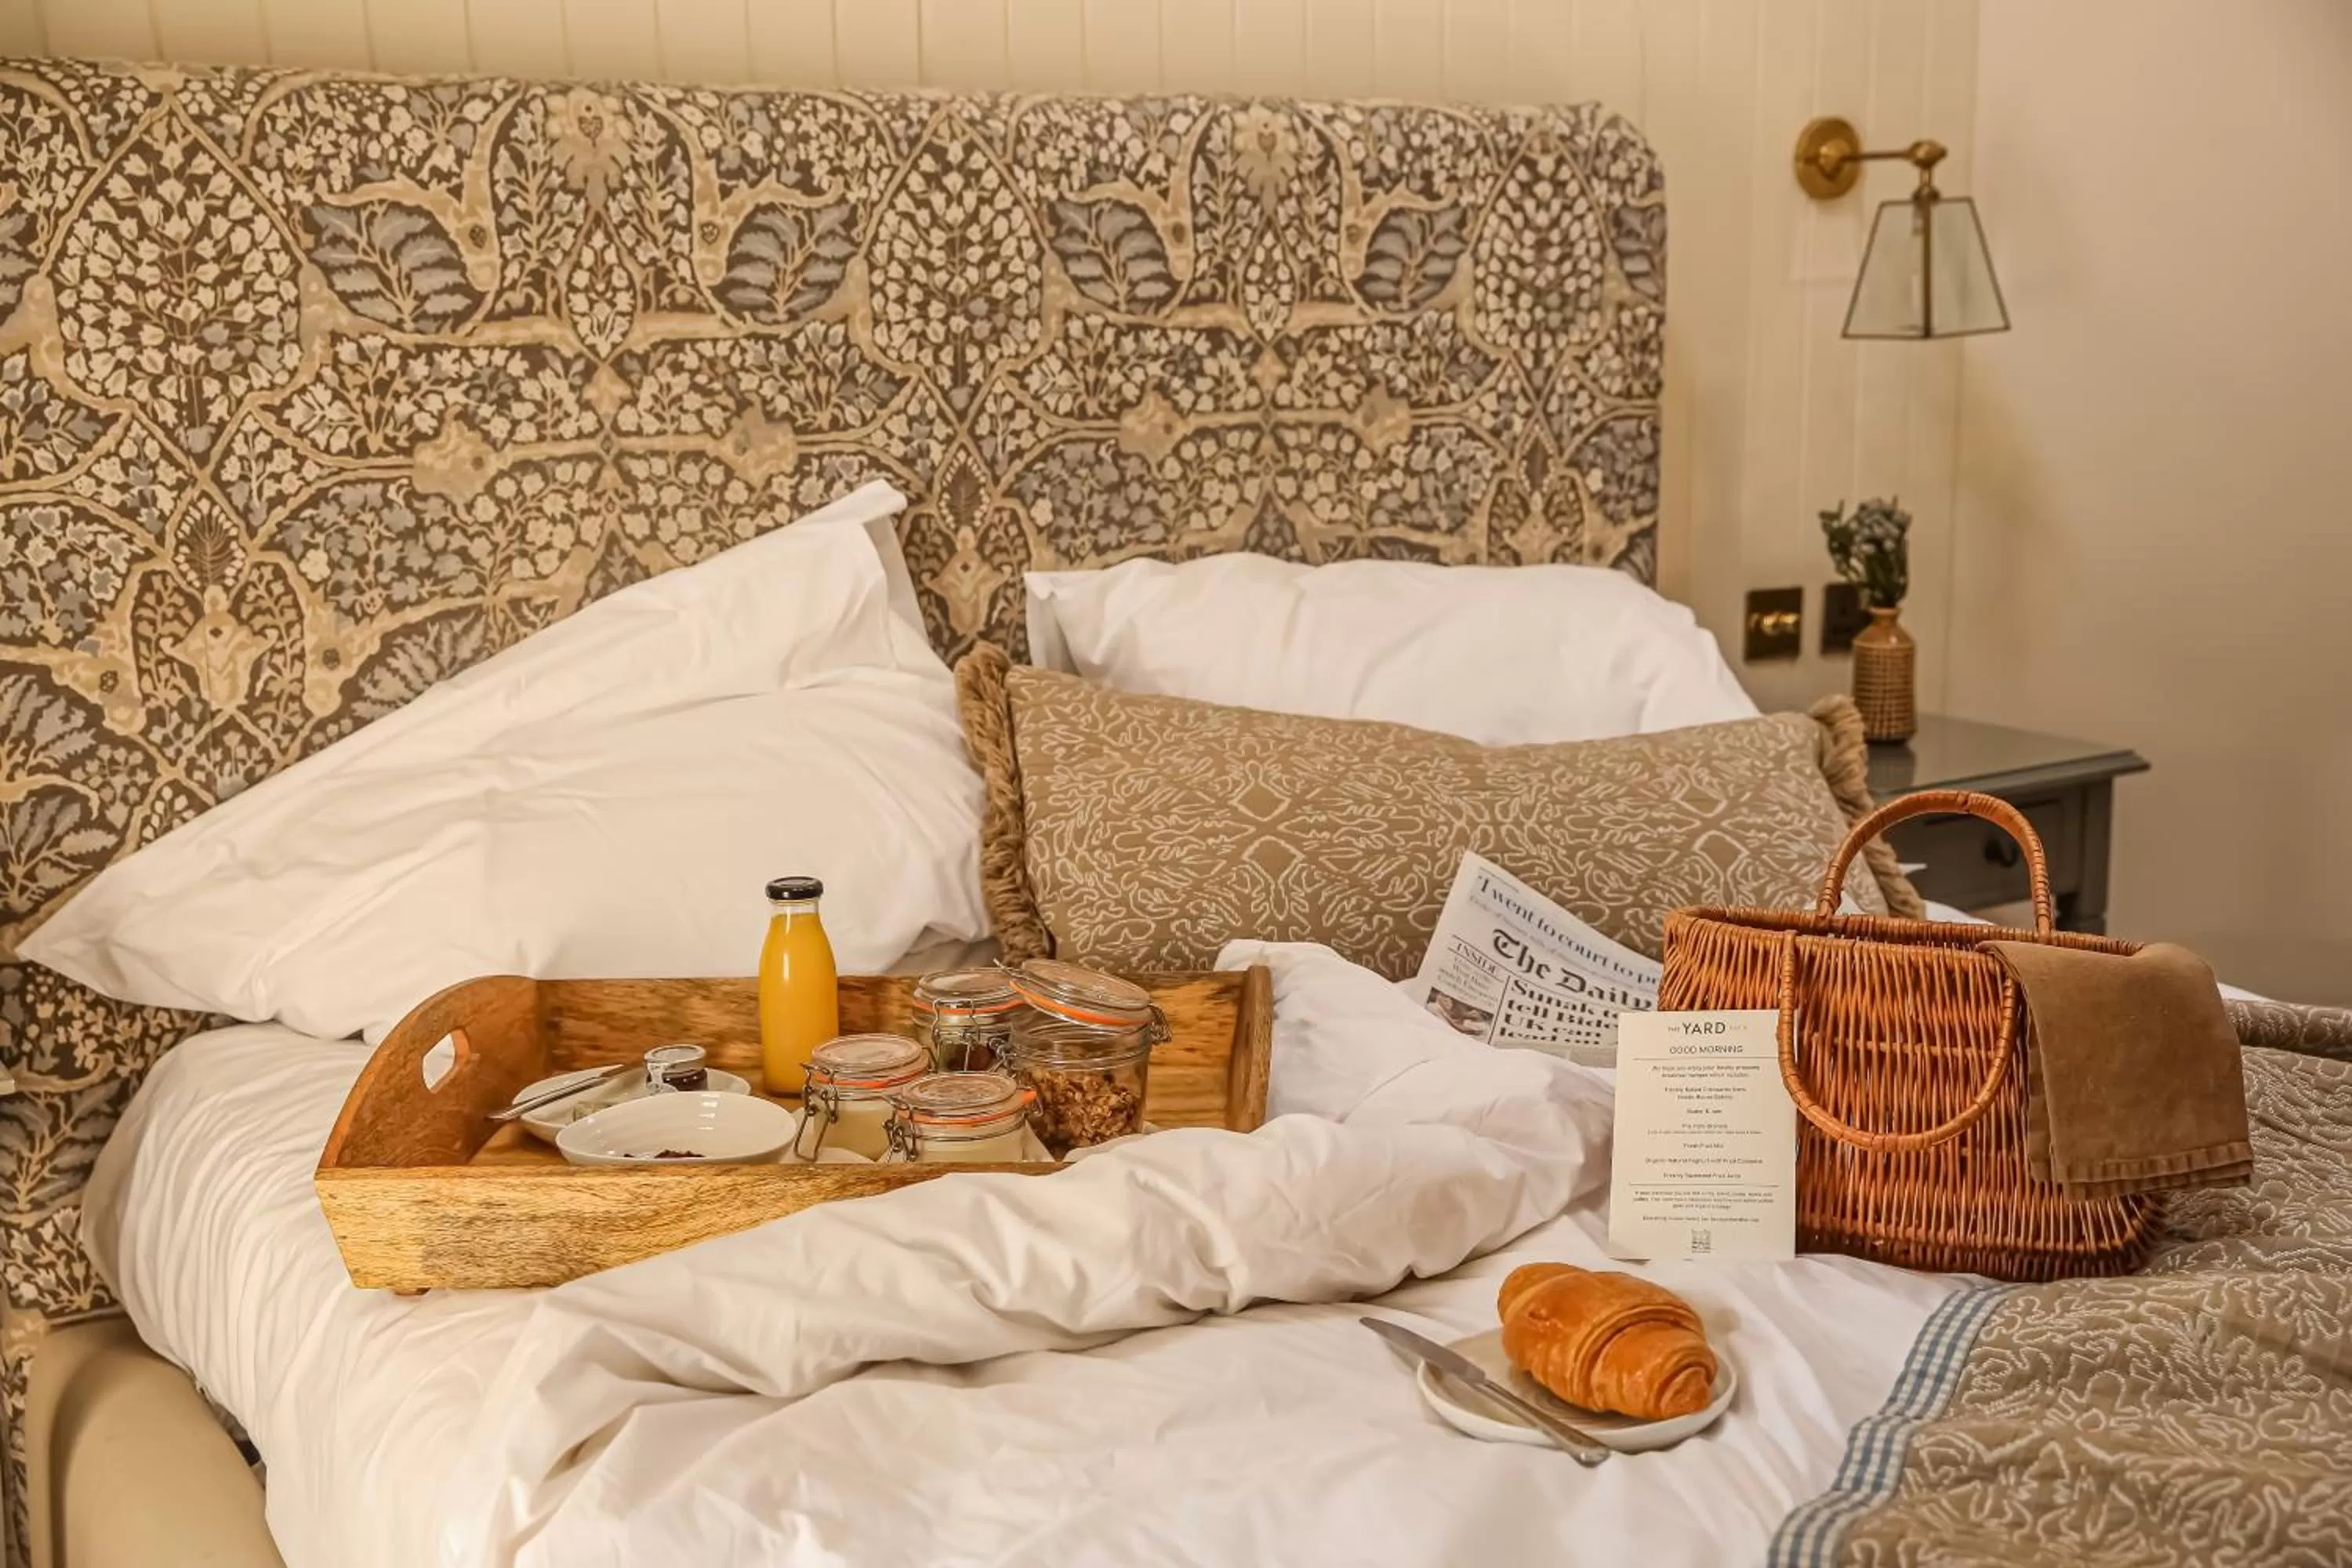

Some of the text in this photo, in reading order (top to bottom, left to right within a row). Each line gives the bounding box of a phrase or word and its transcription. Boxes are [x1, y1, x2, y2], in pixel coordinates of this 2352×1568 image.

[1492, 887, 1534, 922] went
[1537, 918, 1555, 937] to
[1558, 934, 1608, 967] court
[1613, 962, 1633, 978] to
[1457, 942, 1496, 975] INSIDE
[1493, 928, 1551, 979] The
[1555, 967, 1653, 1012] Daily
[1511, 979, 1594, 1015] Sunak
[1504, 1012, 1544, 1031] UK
[1507, 999, 1619, 1029] tell Bide
[1682, 1022, 1726, 1035] YARD
[1669, 1044, 1744, 1054] GOOD MORNING
